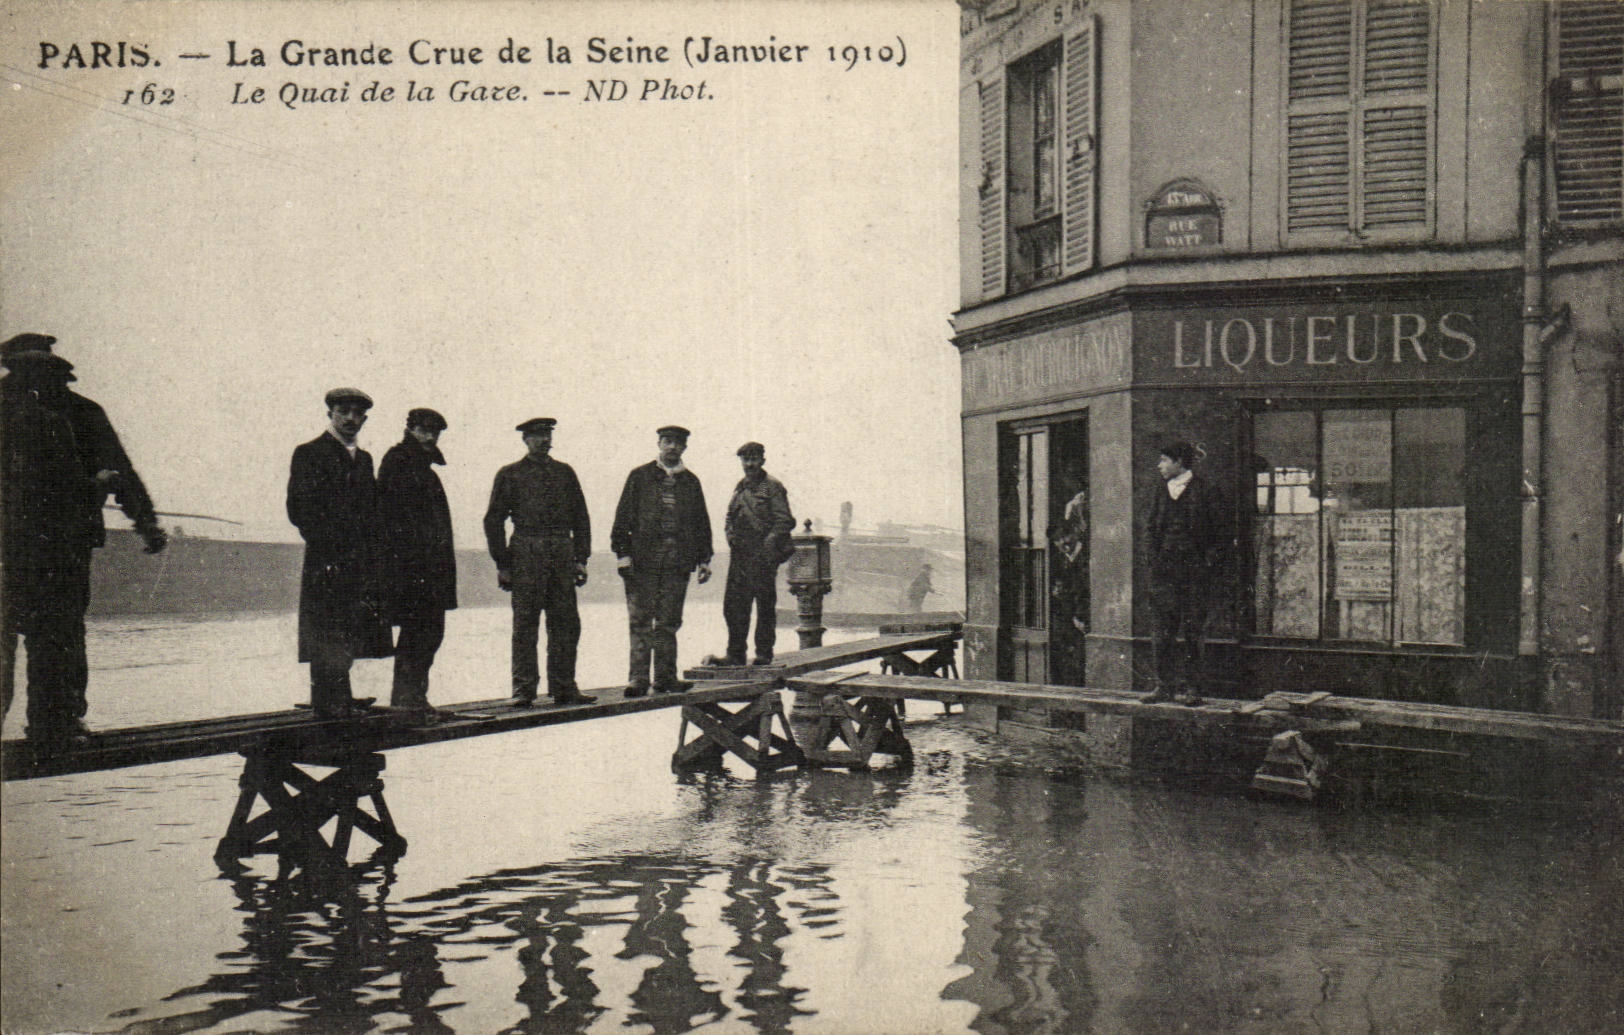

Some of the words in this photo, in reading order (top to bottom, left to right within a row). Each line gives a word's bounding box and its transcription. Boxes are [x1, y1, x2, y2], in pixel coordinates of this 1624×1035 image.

[1168, 219, 1198, 232] RUE
[1164, 234, 1202, 246] WATT
[1174, 311, 1477, 373] LIQUEURS
